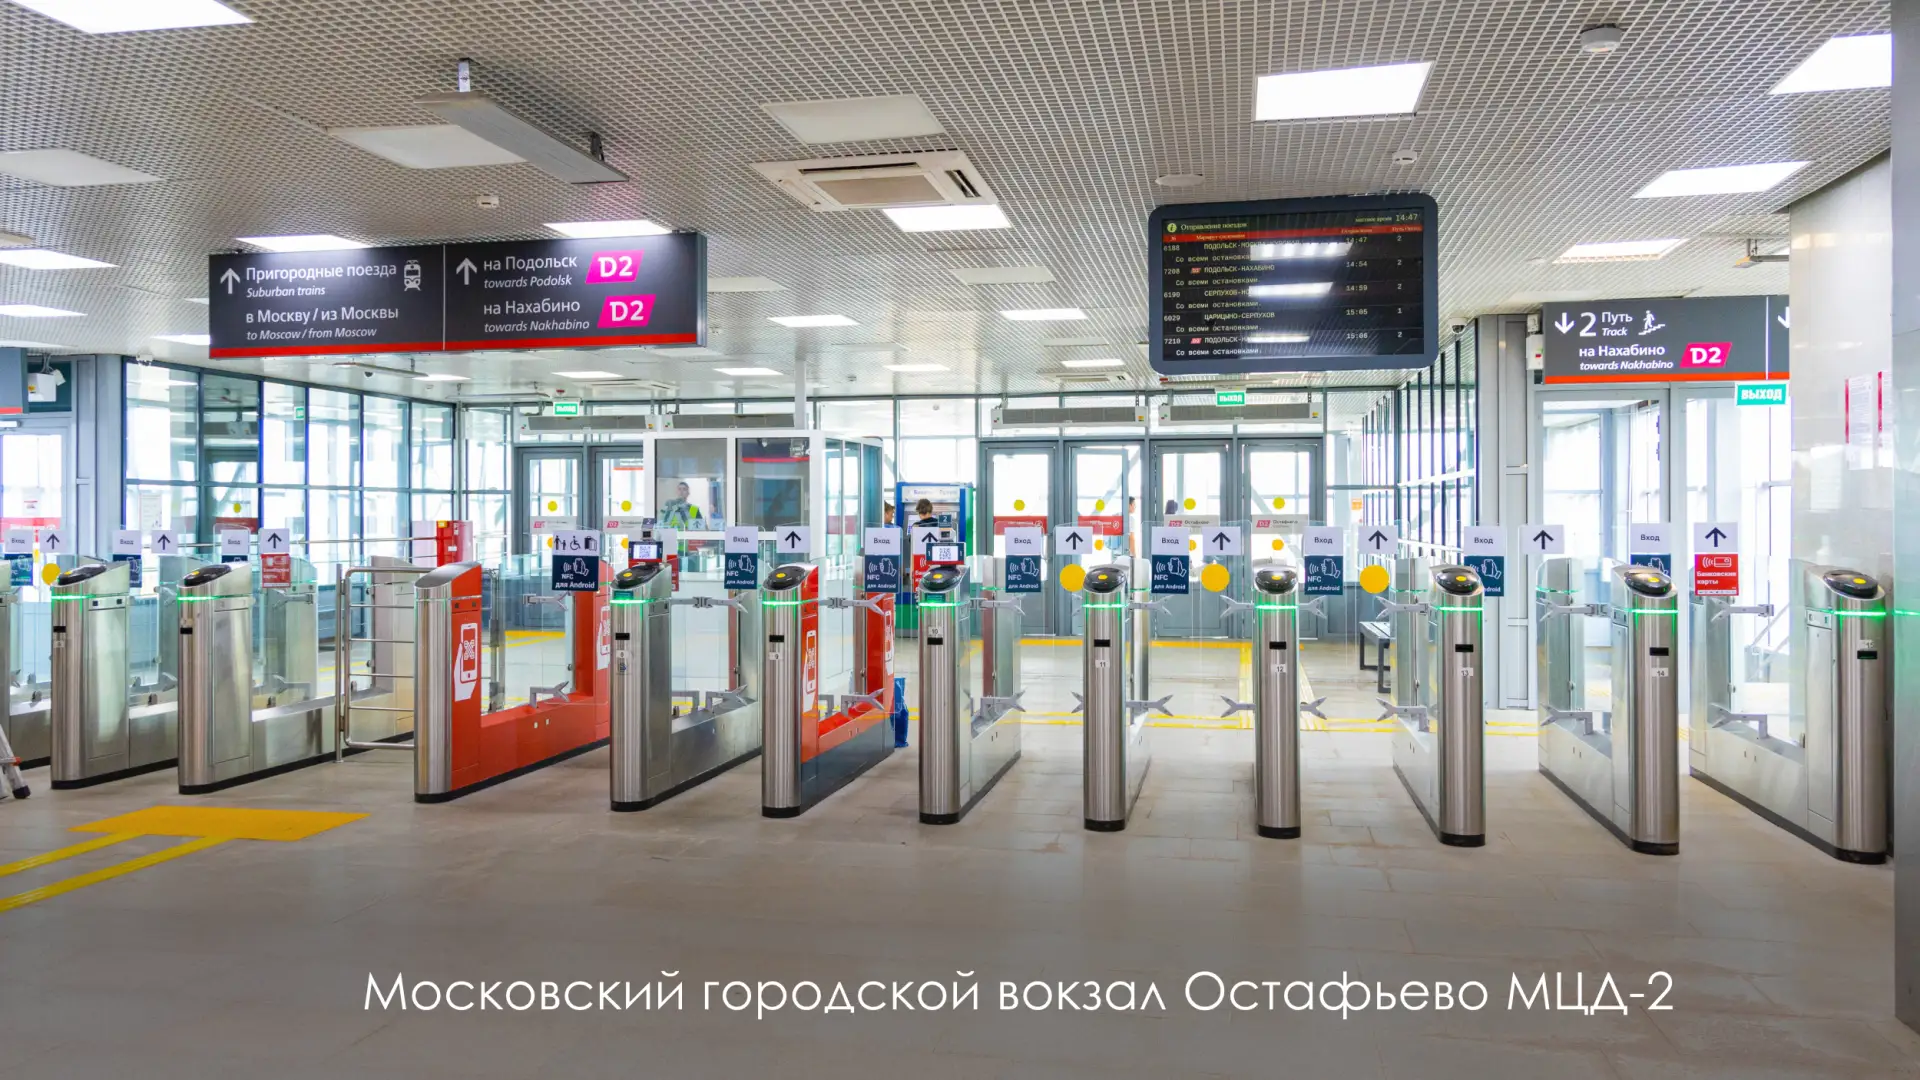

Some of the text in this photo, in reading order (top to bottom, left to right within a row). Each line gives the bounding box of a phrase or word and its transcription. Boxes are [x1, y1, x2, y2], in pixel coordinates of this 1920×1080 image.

[484, 255, 578, 271] на Подольск
[598, 256, 633, 278] D2
[1204, 265, 1275, 273] ПОДОЛЬСК-НАХАБИНО
[246, 264, 397, 283] Пригородные поезда
[484, 275, 572, 289] towards Podolsk
[246, 285, 325, 298] Suburban trains
[484, 298, 581, 315] на Нахабино
[610, 300, 644, 322] D2
[246, 306, 399, 325] в Москву / из Москвы
[1204, 312, 1275, 320] ЦАРИЦЫНО-СЕРПУХОВ
[1601, 311, 1633, 325] Путь
[484, 319, 590, 333] towards Nakhabino
[1579, 312, 1597, 337] 2
[246, 327, 377, 340] to Moscow / from Moscow
[1602, 328, 1628, 336] Track
[1579, 343, 1665, 357] на Нахабино
[1690, 347, 1722, 364] D2
[1580, 360, 1674, 371] towards Nakhabino
[1741, 388, 1782, 401] ВЫХОД
[1162, 537, 1180, 545] Вход
[1314, 536, 1333, 544] Вход
[1640, 534, 1660, 542] Вход
